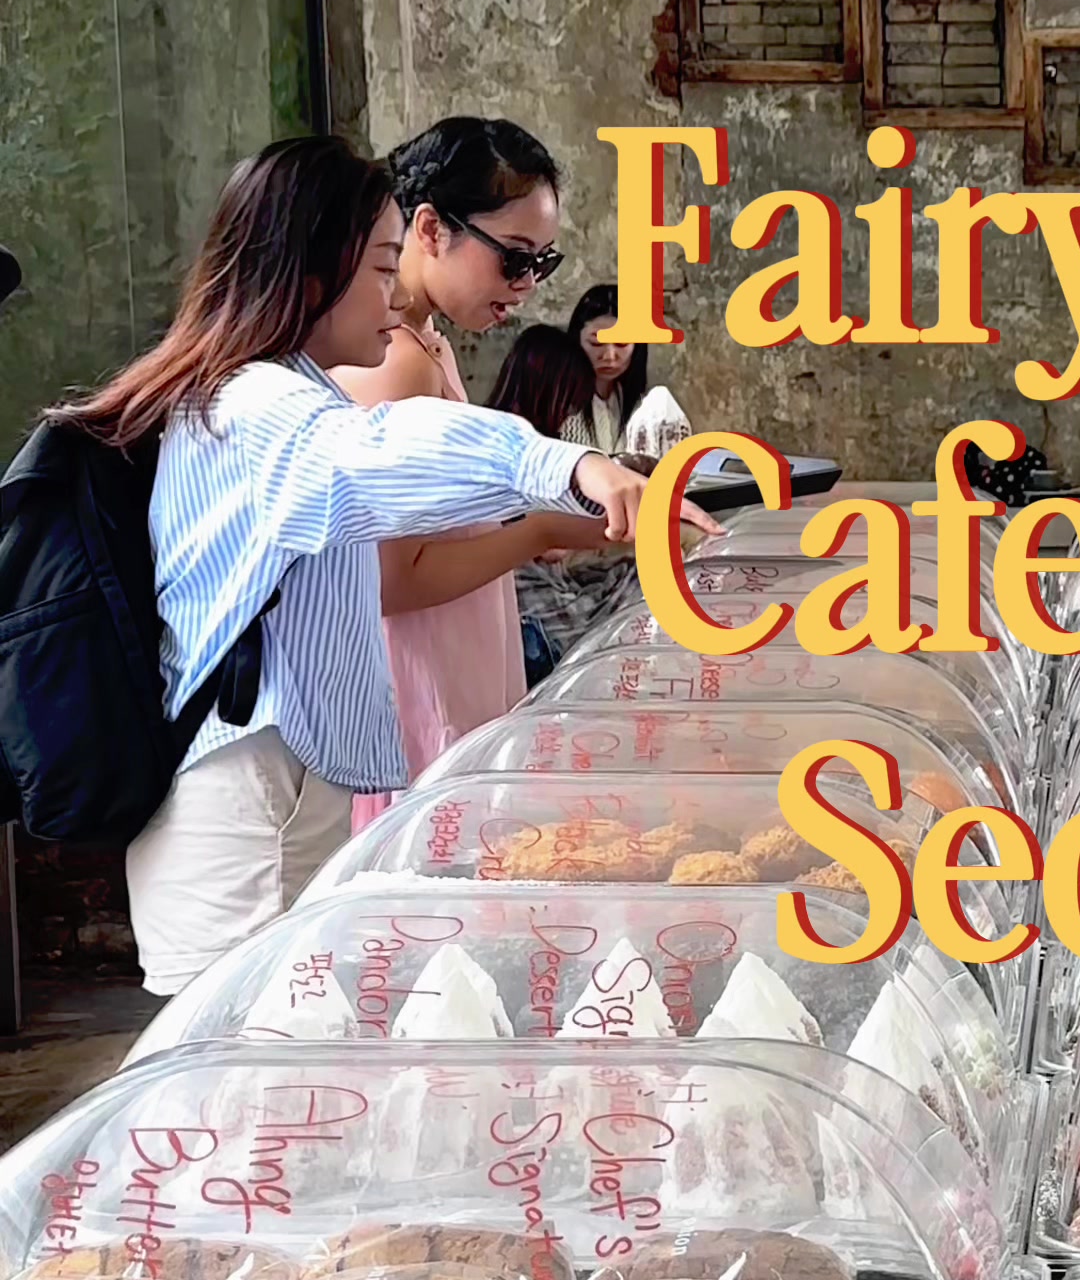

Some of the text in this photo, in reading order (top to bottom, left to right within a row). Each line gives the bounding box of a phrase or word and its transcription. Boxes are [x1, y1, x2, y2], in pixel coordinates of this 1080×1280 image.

[357, 915, 464, 1038] Pandor
[117, 1128, 220, 1280] Butter
[200, 1083, 369, 1234] Ahng
[582, 1112, 675, 1258] Chef's
